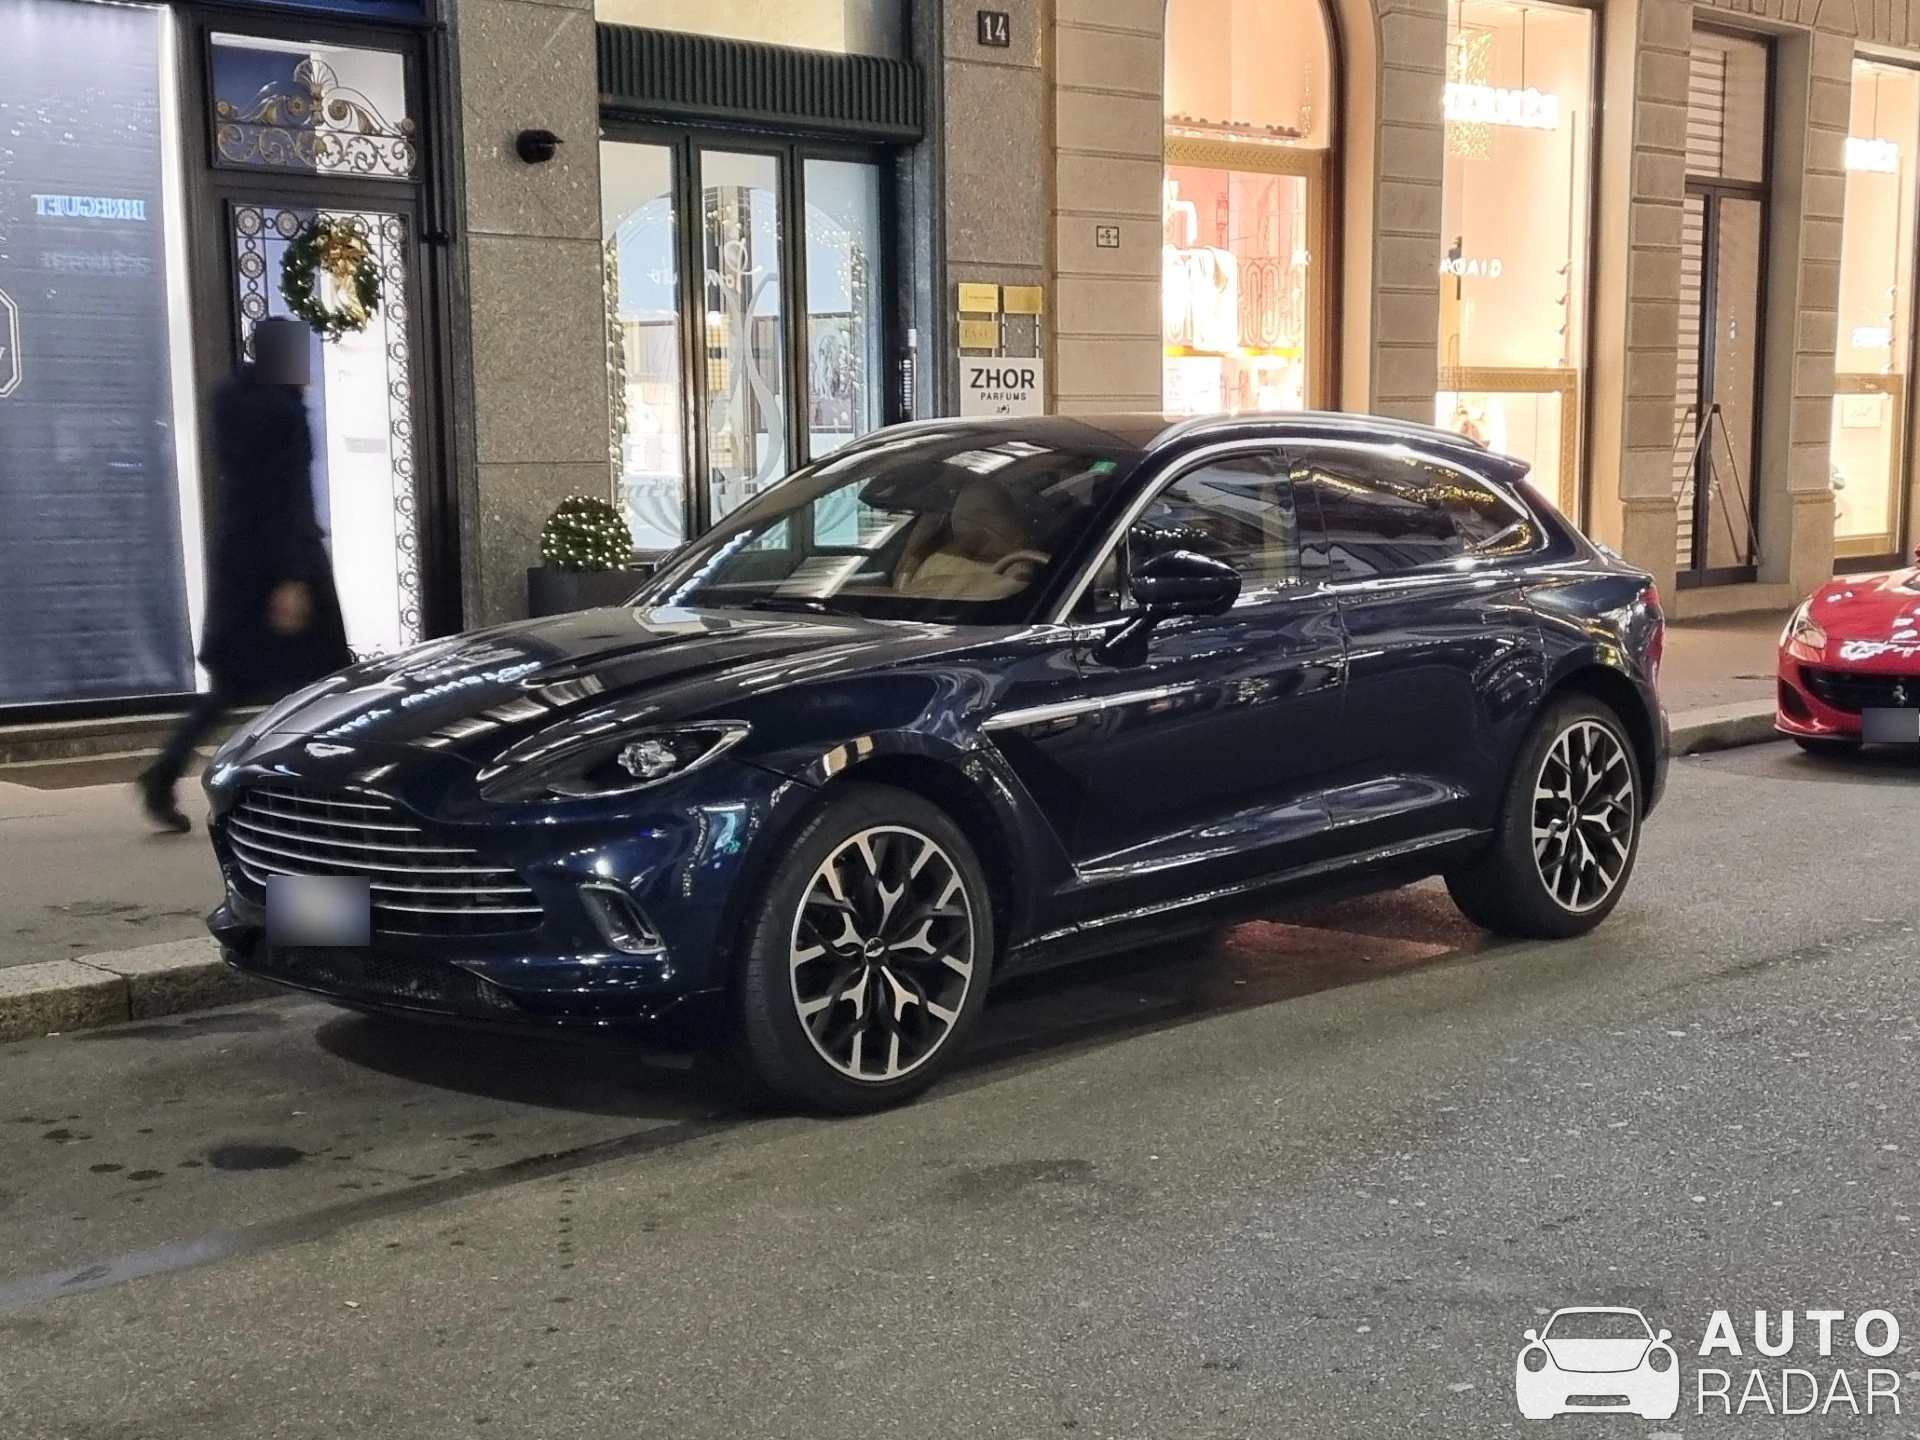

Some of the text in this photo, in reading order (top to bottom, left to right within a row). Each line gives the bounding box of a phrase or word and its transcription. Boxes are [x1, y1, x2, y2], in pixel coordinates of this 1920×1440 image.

[984, 15, 1006, 41] 14
[969, 368, 1035, 389] ZHOR
[980, 392, 1027, 402] PARFUMS
